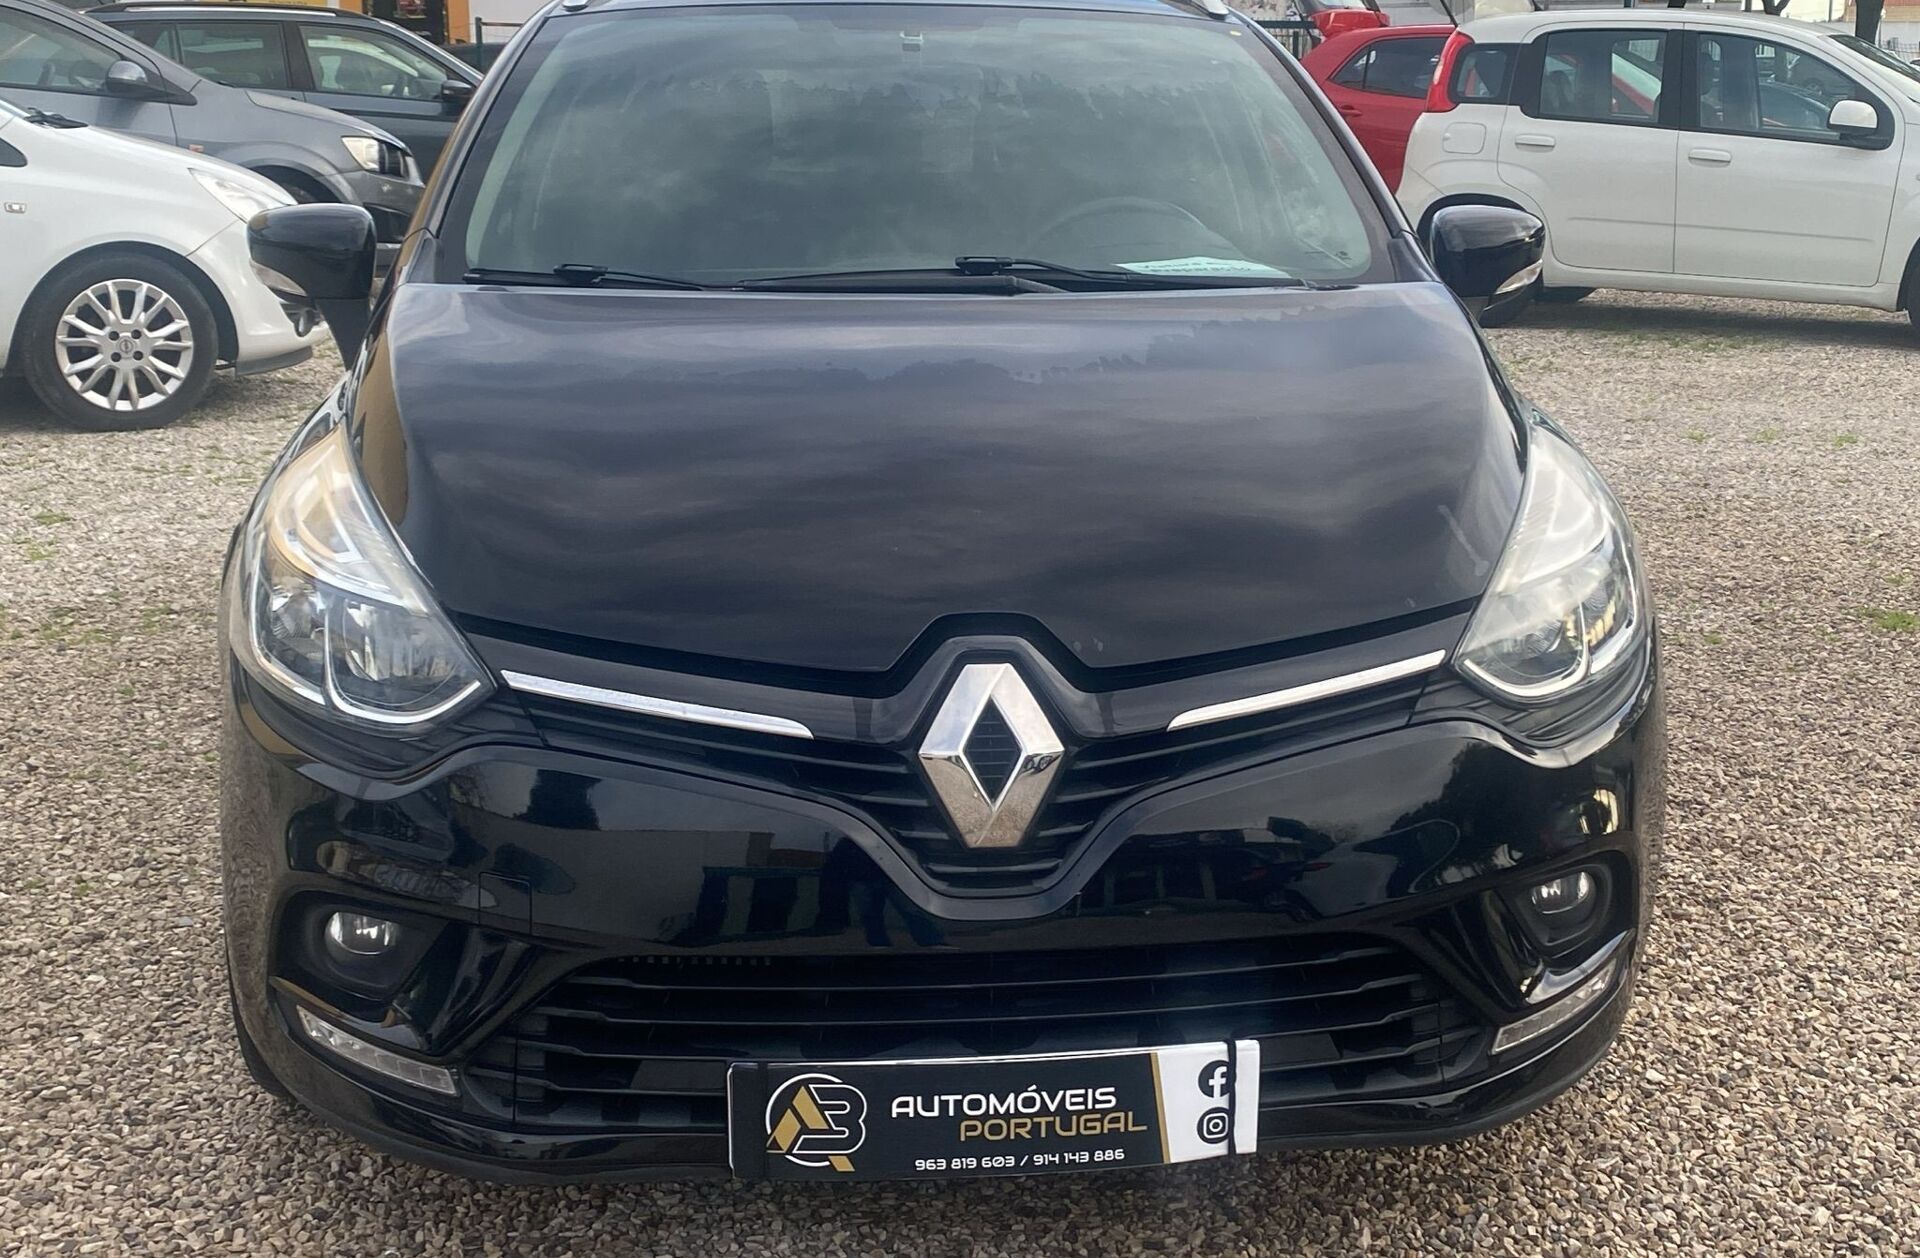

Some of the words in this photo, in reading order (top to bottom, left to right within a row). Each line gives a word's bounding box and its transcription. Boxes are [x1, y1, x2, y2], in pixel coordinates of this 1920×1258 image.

[891, 1084, 1117, 1118] AUTOMÓVEIS
[960, 1111, 1148, 1142] PORTUGAL
[915, 1158, 946, 1171] 963
[951, 1157, 977, 1169] 819
[981, 1155, 1015, 1168] 603
[1020, 1155, 1029, 1167] /
[1033, 1153, 1060, 1166] 914
[1063, 1151, 1089, 1164] 143
[1094, 1148, 1125, 1162] 886
